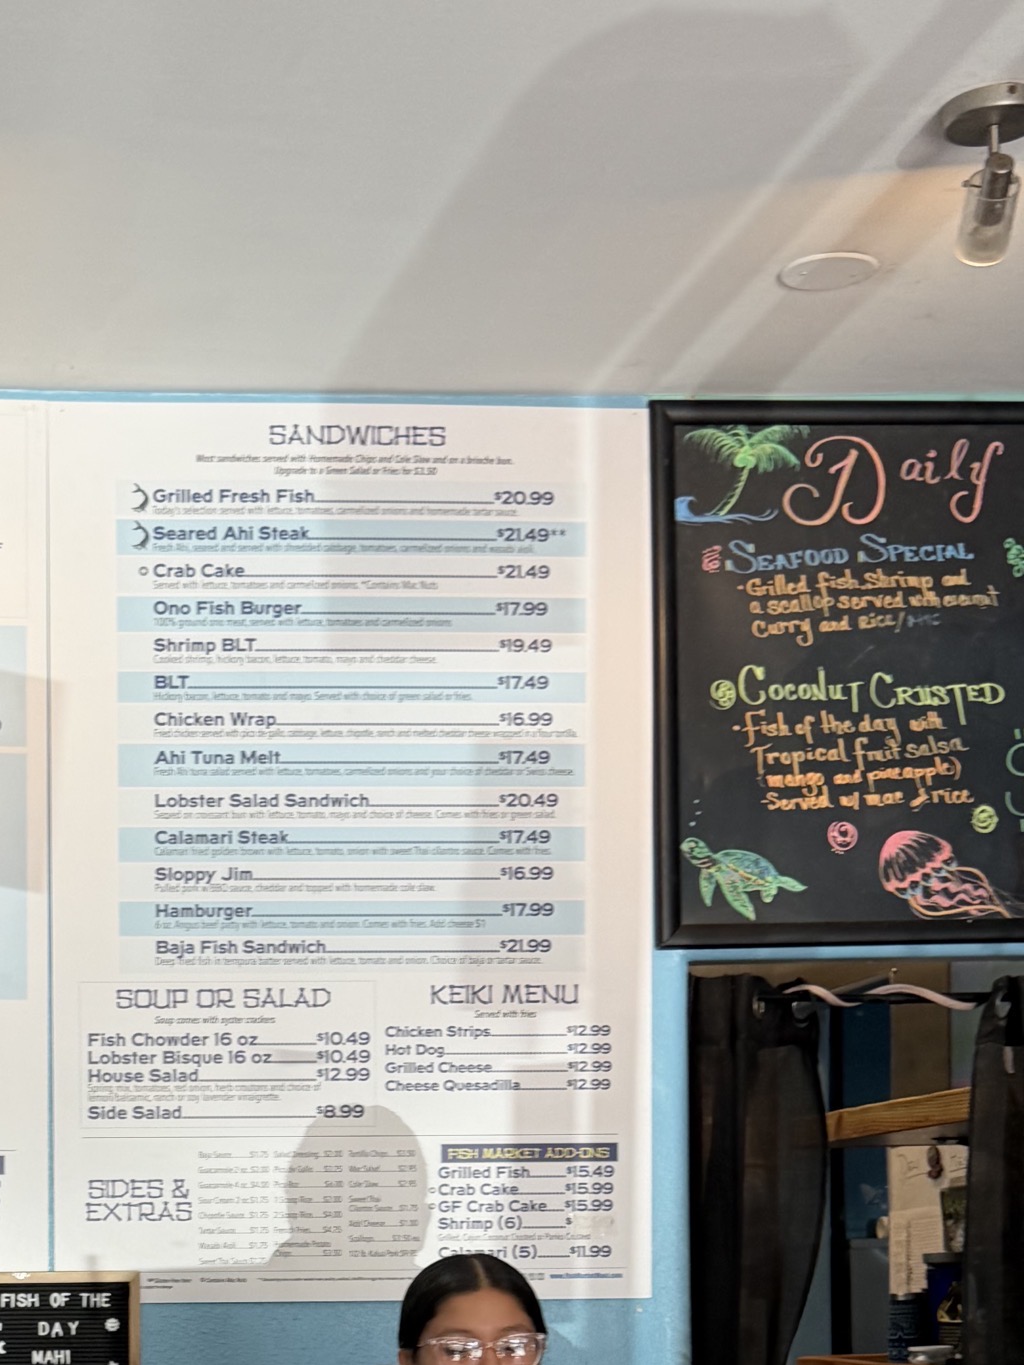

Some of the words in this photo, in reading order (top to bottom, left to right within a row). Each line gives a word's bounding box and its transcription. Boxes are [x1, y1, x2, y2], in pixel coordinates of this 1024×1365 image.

[269, 424, 447, 448] SANDWICHES
[152, 488, 213, 504] Grilled
[218, 488, 272, 504] Fresh
[277, 488, 316, 504] Fish
[493, 490, 554, 506] $20.99
[152, 526, 217, 542] Seared
[221, 526, 255, 542] Ahi
[259, 526, 310, 542] Steak
[153, 600, 191, 616] Ono
[196, 600, 234, 616] Fish
[239, 601, 302, 620] Burger
[495, 601, 548, 616] $17.99
[154, 676, 189, 690] BLT
[496, 674, 549, 690] $17.49
[154, 712, 228, 728] Chicken
[231, 712, 278, 730] Wrap
[498, 712, 553, 727] $16.99
[820, 710, 856, 735] the
[858, 714, 902, 745] day
[154, 793, 225, 809] Lobster
[229, 793, 280, 809] Salad
[284, 793, 370, 809] Sandwich
[498, 792, 559, 808] $20.49
[154, 867, 216, 885] Sloppy
[220, 867, 254, 882] Jim
[500, 866, 554, 882] $16.99
[155, 903, 254, 922] Hamburger
[502, 902, 554, 918] $17.99
[116, 988, 190, 1009] SOUP
[195, 988, 236, 1010] OR
[243, 988, 332, 1009] SALAD
[430, 984, 495, 1006] KEIKI
[502, 984, 580, 1006] MENU
[88, 1050, 156, 1066] Lobster
[159, 1050, 225, 1069] Bisque
[227, 1050, 251, 1066] 16
[254, 1054, 272, 1066] oz
[316, 1049, 370, 1064] $10.49
[384, 1078, 435, 1092] Cheese
[438, 1078, 521, 1092] Quesadilla
[568, 1078, 612, 1092] $12.99
[88, 1105, 128, 1121] Side
[132, 1105, 182, 1120] Salad
[316, 1105, 364, 1118] $8.99
[0, 1293, 40, 1308] FISH
[49, 1293, 70, 1307] OF
[81, 1292, 112, 1308] THE
[38, 1321, 80, 1338] DAY
[31, 1350, 71, 1365] MAHI
